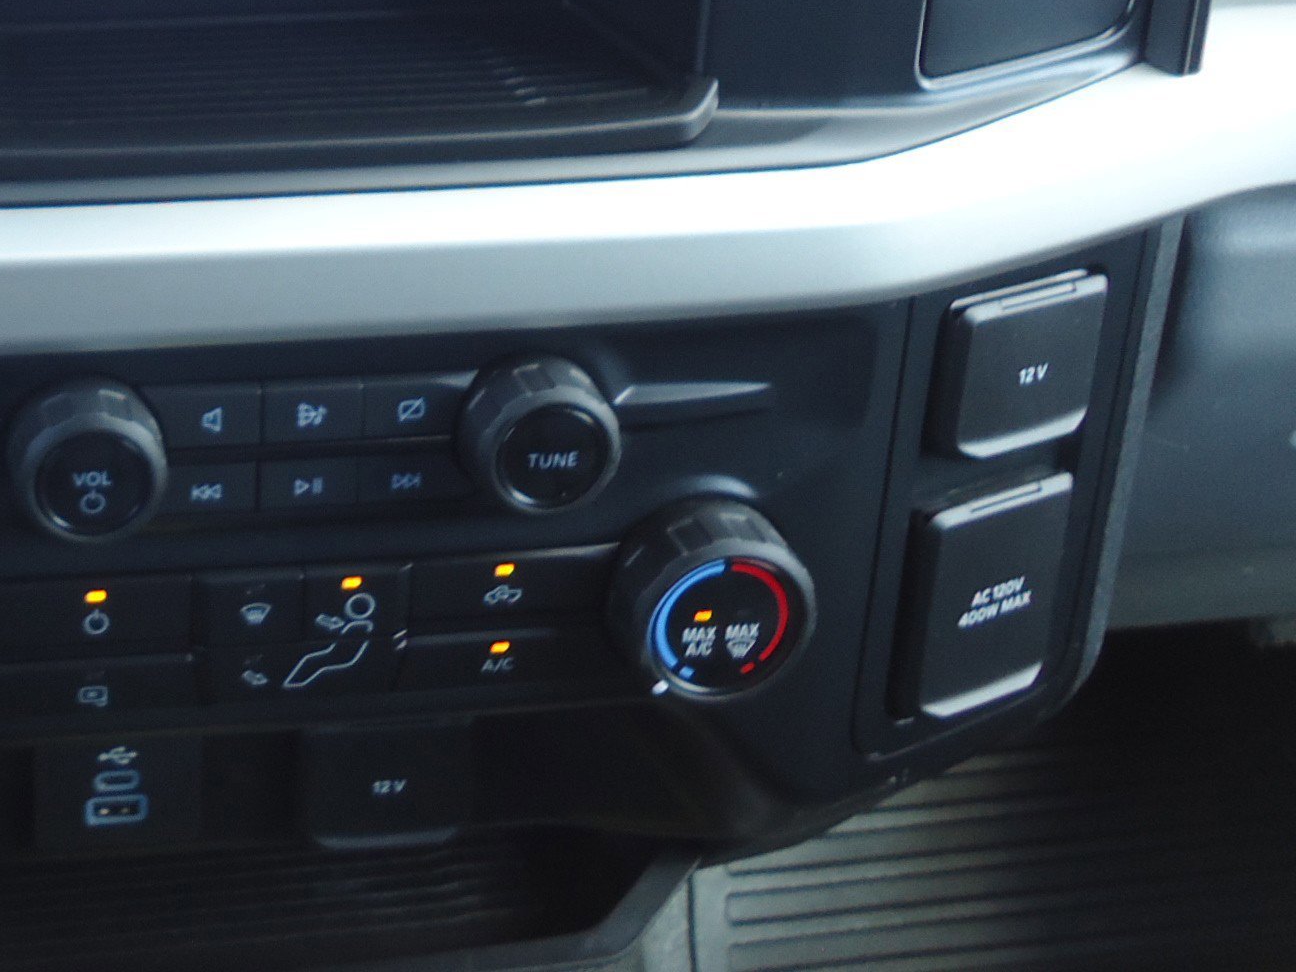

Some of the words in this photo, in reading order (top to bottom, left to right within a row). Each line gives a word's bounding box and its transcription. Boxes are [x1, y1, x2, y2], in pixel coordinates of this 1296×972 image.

[527, 450, 578, 470] TUNE
[72, 471, 112, 487] VOL
[971, 588, 991, 608] AC
[958, 601, 999, 629] 400W
[1000, 589, 1032, 613] MAX
[681, 625, 717, 644] MAX
[724, 622, 760, 641] MAX
[684, 640, 713, 658] A/C
[480, 656, 516, 674] A/C
